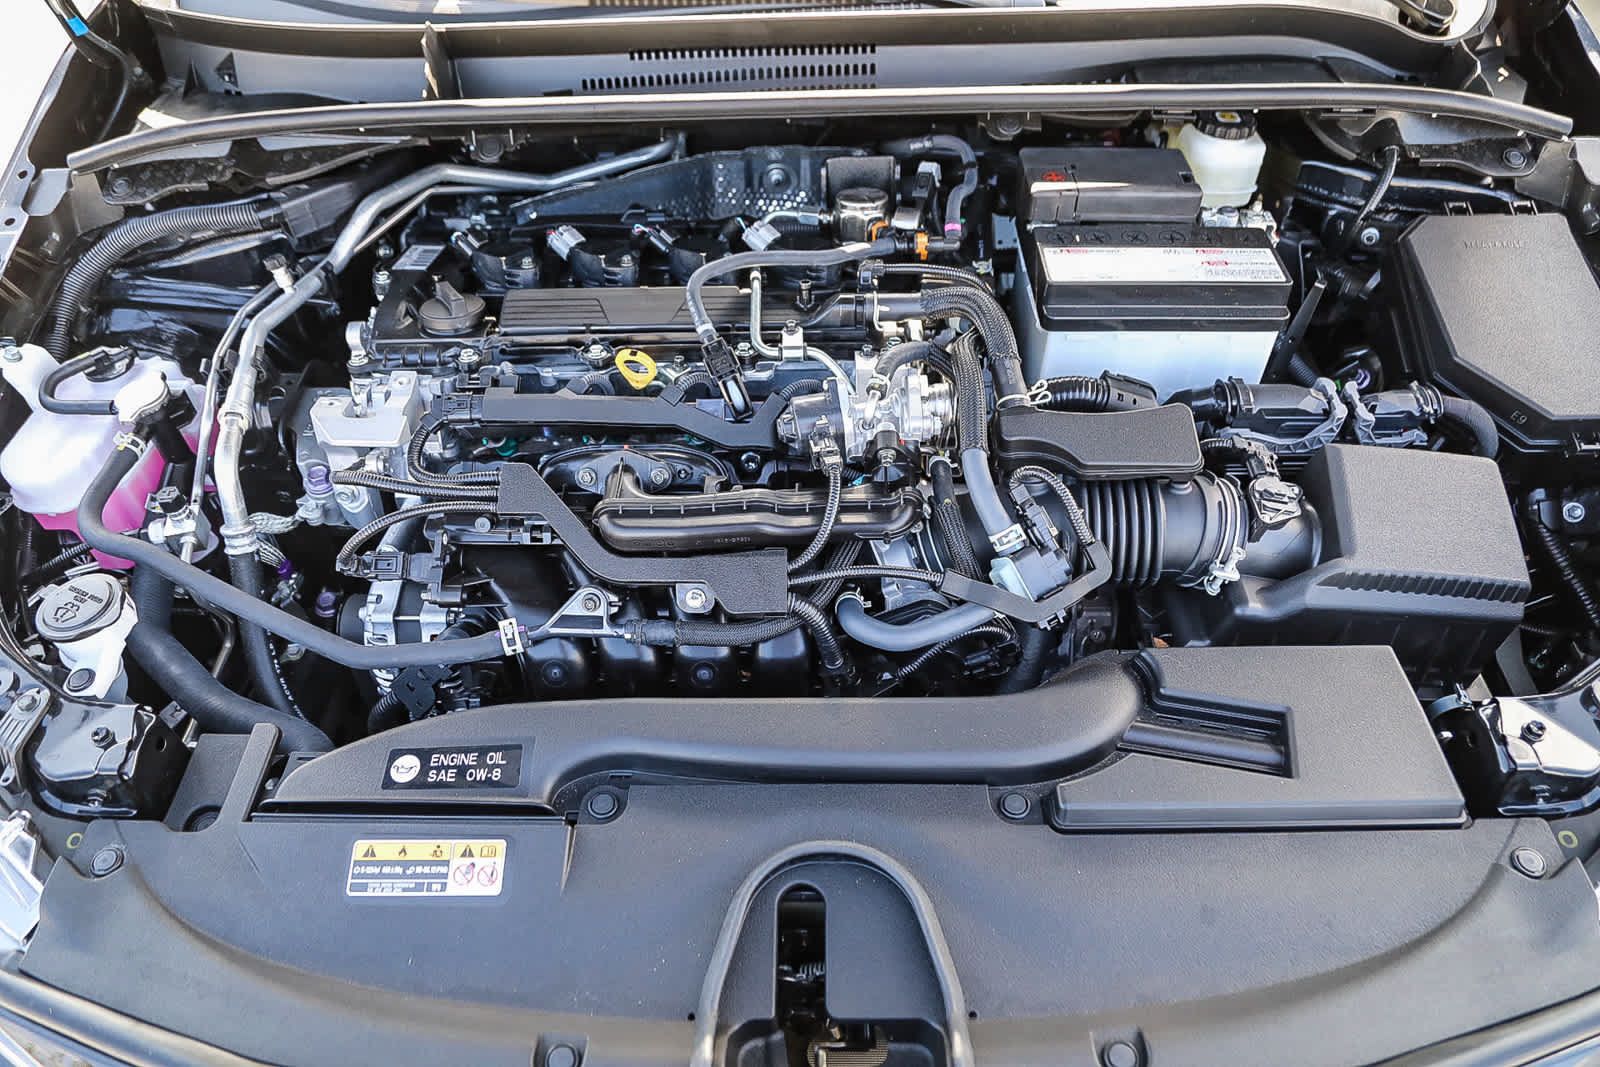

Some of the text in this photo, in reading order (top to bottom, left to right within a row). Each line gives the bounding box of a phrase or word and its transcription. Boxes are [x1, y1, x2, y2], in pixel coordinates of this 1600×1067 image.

[430, 751, 507, 767] ENGINE OIL
[427, 768, 502, 782] SAE 0W-8
